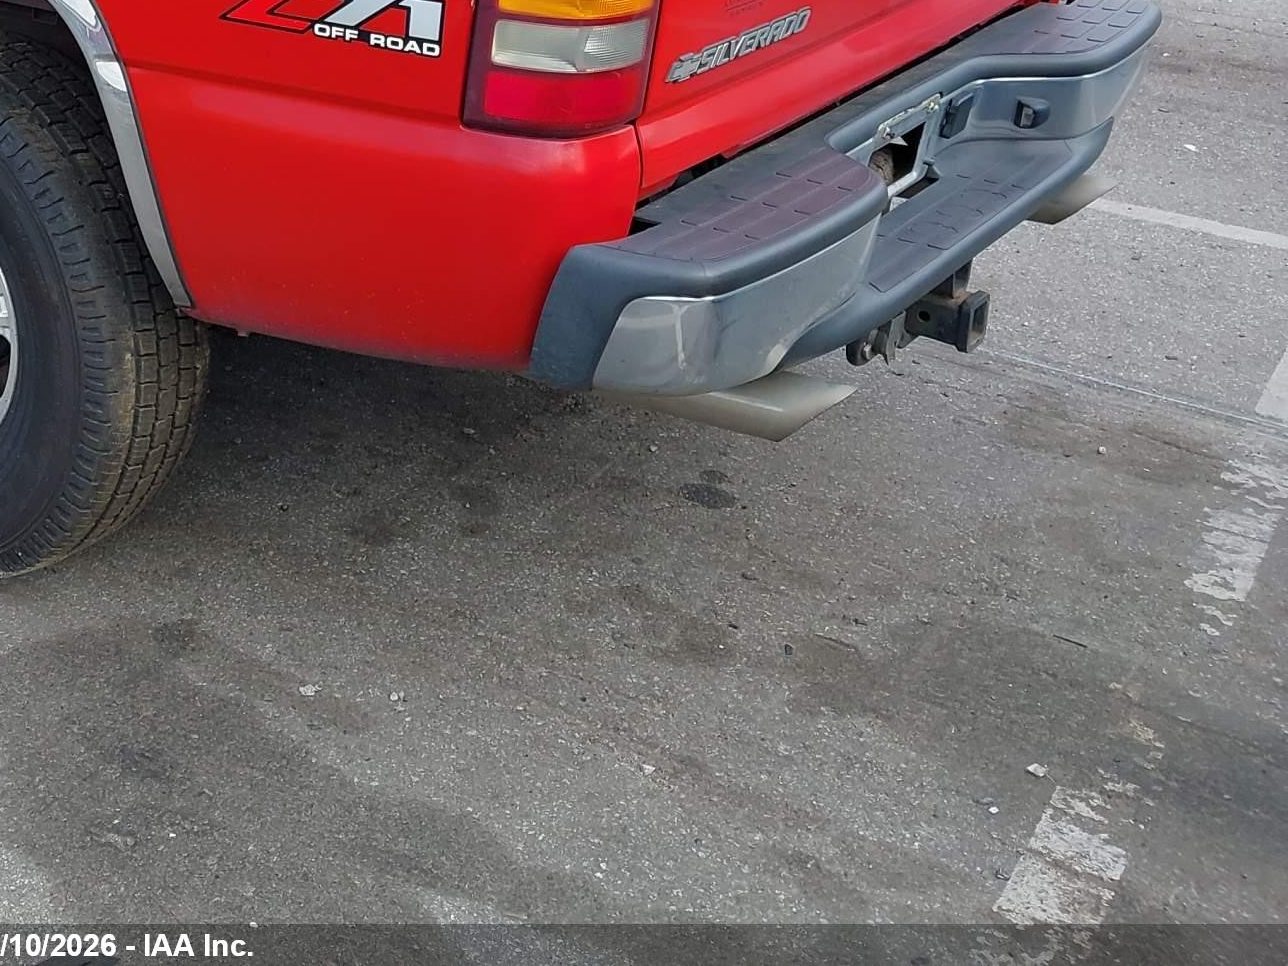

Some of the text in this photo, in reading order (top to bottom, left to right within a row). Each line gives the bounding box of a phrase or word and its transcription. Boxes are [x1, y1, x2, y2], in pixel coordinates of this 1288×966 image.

[313, 22, 441, 57] OFF ROAD
[696, 6, 812, 75] SILVERADO
